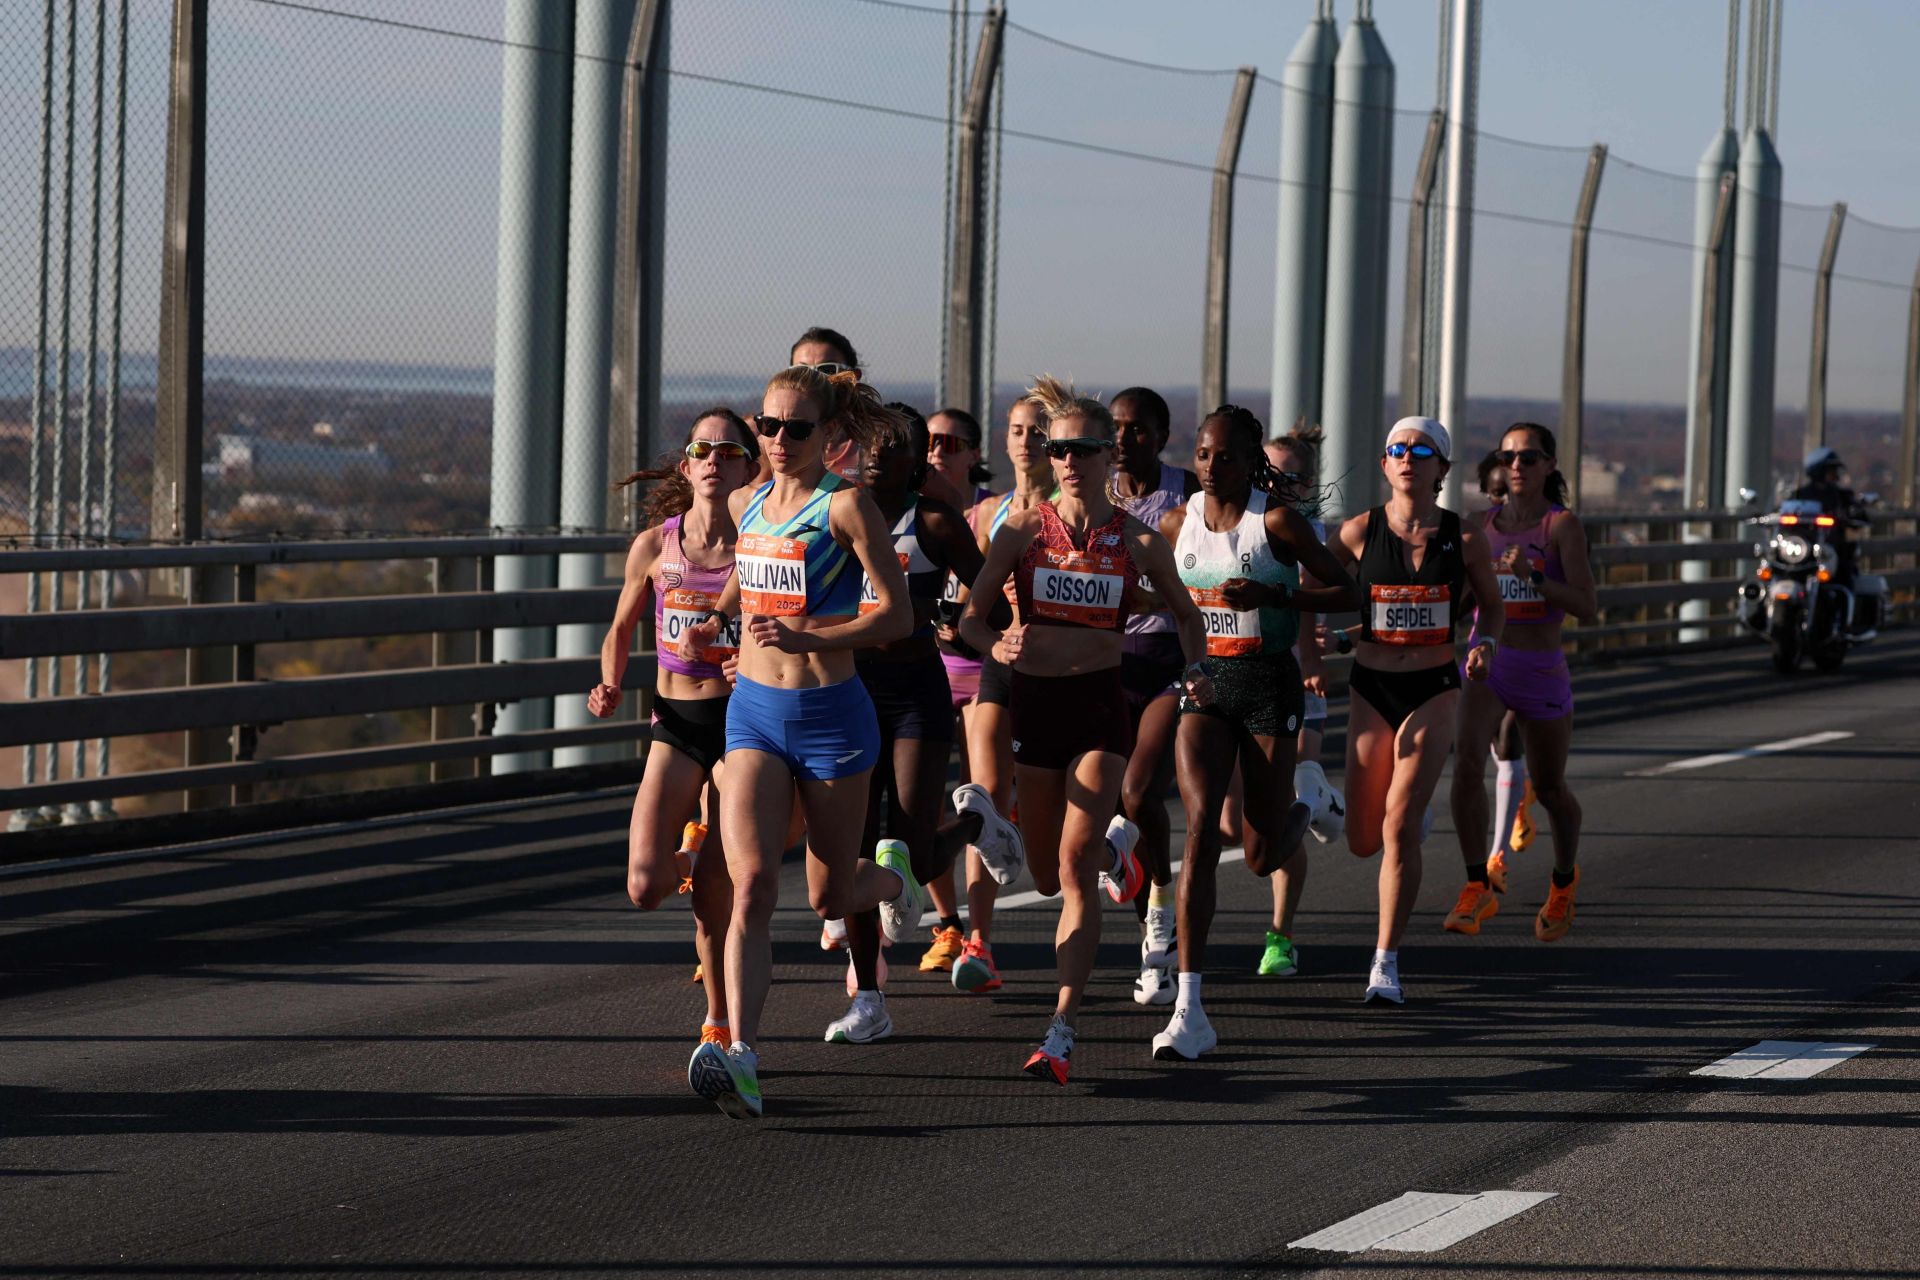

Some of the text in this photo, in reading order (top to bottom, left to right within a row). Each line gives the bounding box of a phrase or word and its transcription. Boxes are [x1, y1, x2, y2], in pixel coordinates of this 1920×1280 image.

[1048, 551, 1067, 565] tcs
[738, 560, 802, 592] SULLIVAN
[674, 592, 694, 605] tcs
[1046, 574, 1110, 605] SISSON
[776, 600, 801, 611] 2025
[1202, 612, 1238, 635] OBIRI
[1386, 607, 1436, 628] SEIDEL
